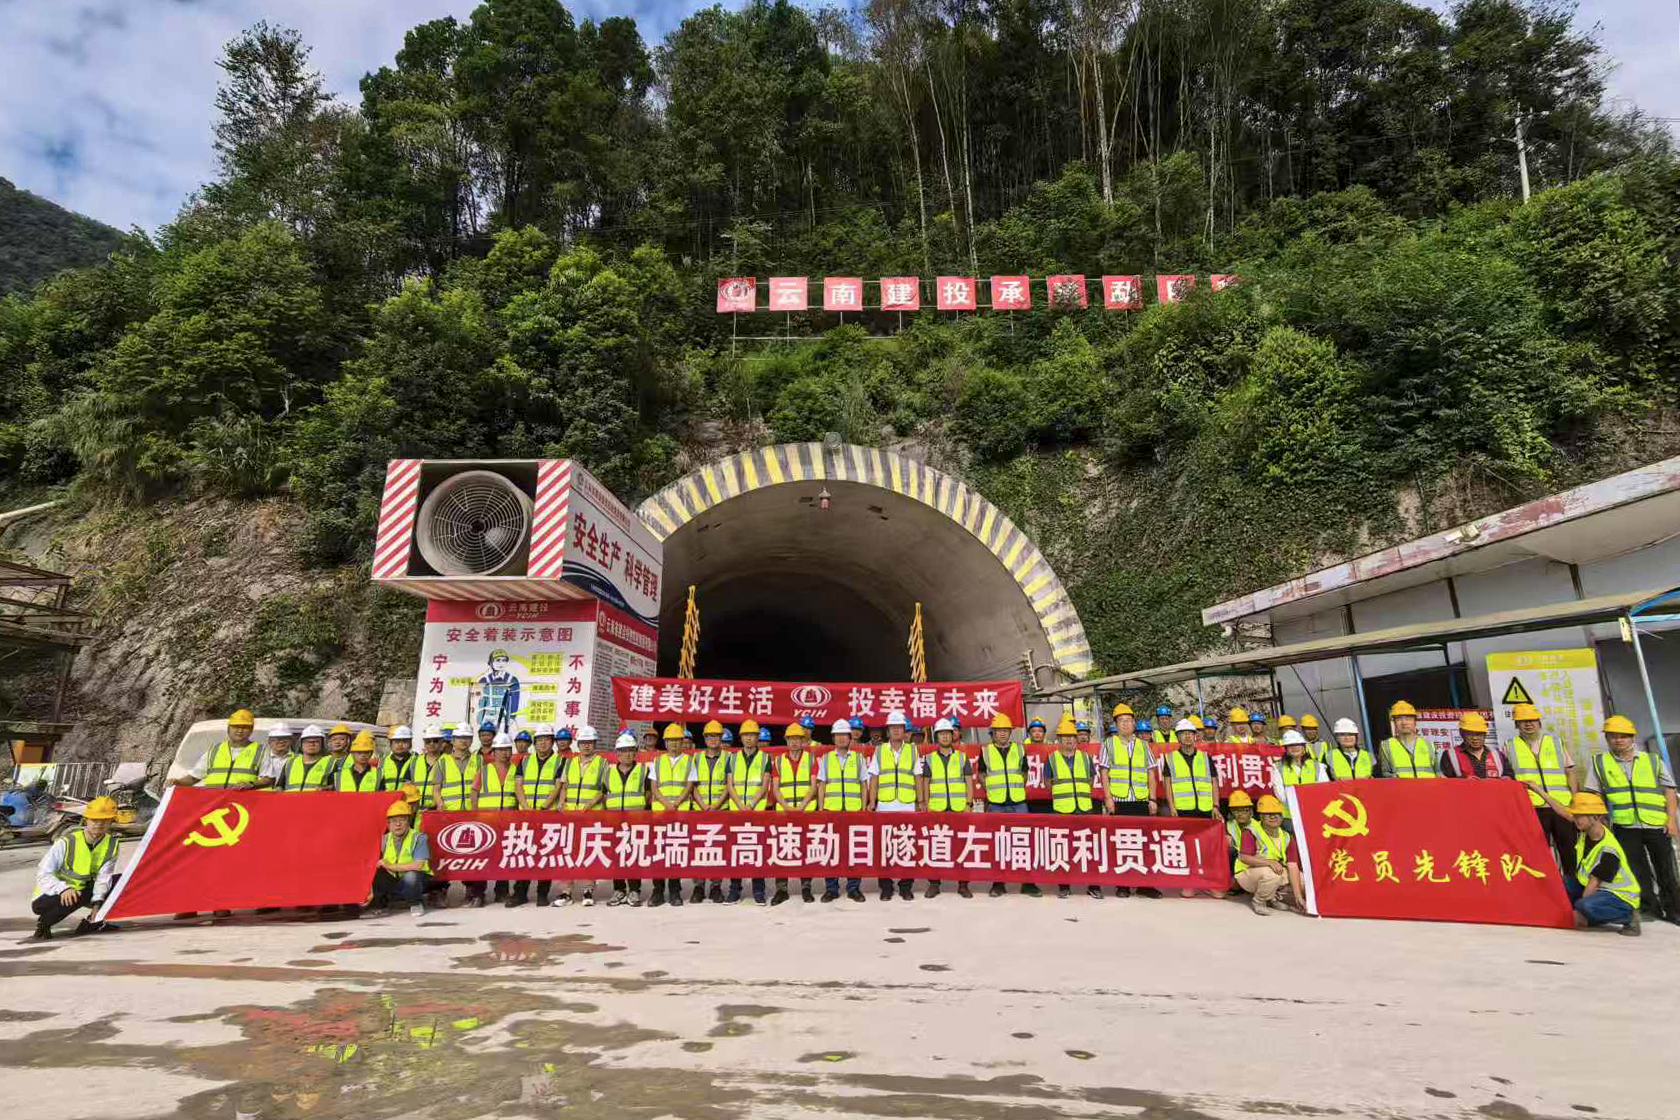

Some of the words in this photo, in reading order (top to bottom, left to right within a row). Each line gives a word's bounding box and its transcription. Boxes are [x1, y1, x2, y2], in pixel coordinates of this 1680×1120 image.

[573, 512, 622, 571] 安全生产
[625, 551, 659, 601] 科学管理
[446, 627, 573, 643] 安全着装示意图
[629, 684, 773, 716] 建美好生活
[848, 687, 1000, 719] 投幸福未来
[792, 708, 827, 718] YCIH
[437, 857, 486, 872] YCIH
[501, 822, 1204, 876] 热烈庆祝瑞孟高速勐目隧道左幅顺利贯通！
[1327, 849, 1547, 884] 党员先锋队
